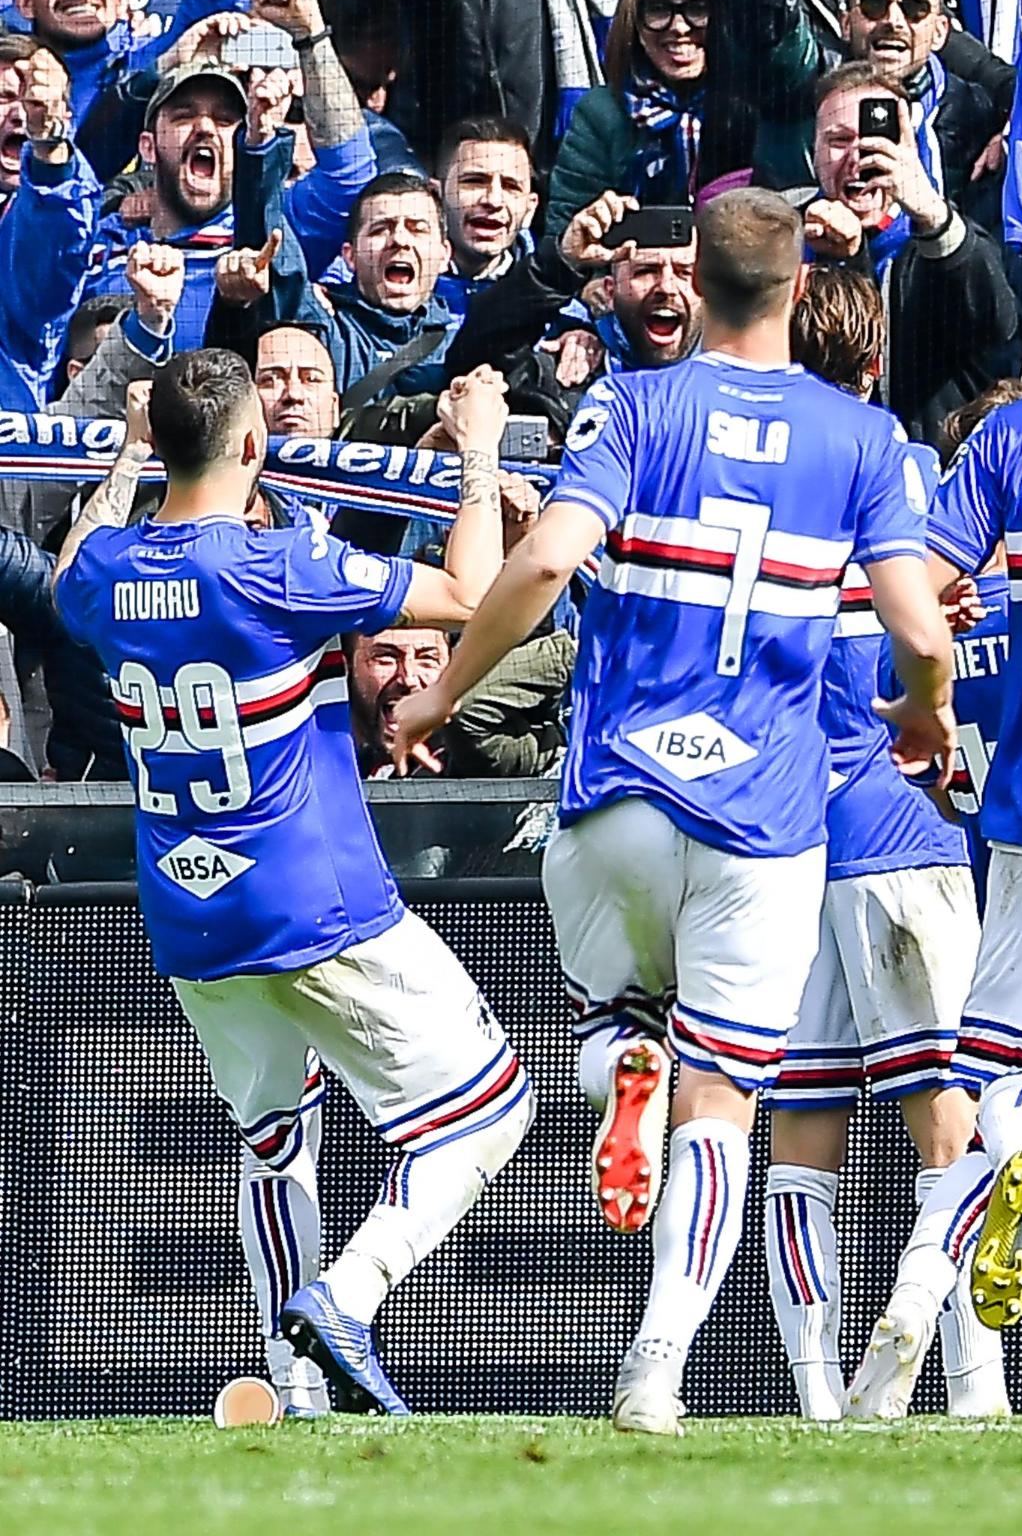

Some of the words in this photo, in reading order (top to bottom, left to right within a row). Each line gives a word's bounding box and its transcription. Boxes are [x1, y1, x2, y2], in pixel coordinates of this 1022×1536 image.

[114, 579, 200, 620] MURRU
[699, 496, 771, 677] 7
[119, 661, 252, 815] 29
[655, 730, 726, 764] IBSA
[168, 855, 232, 882] IBSA
